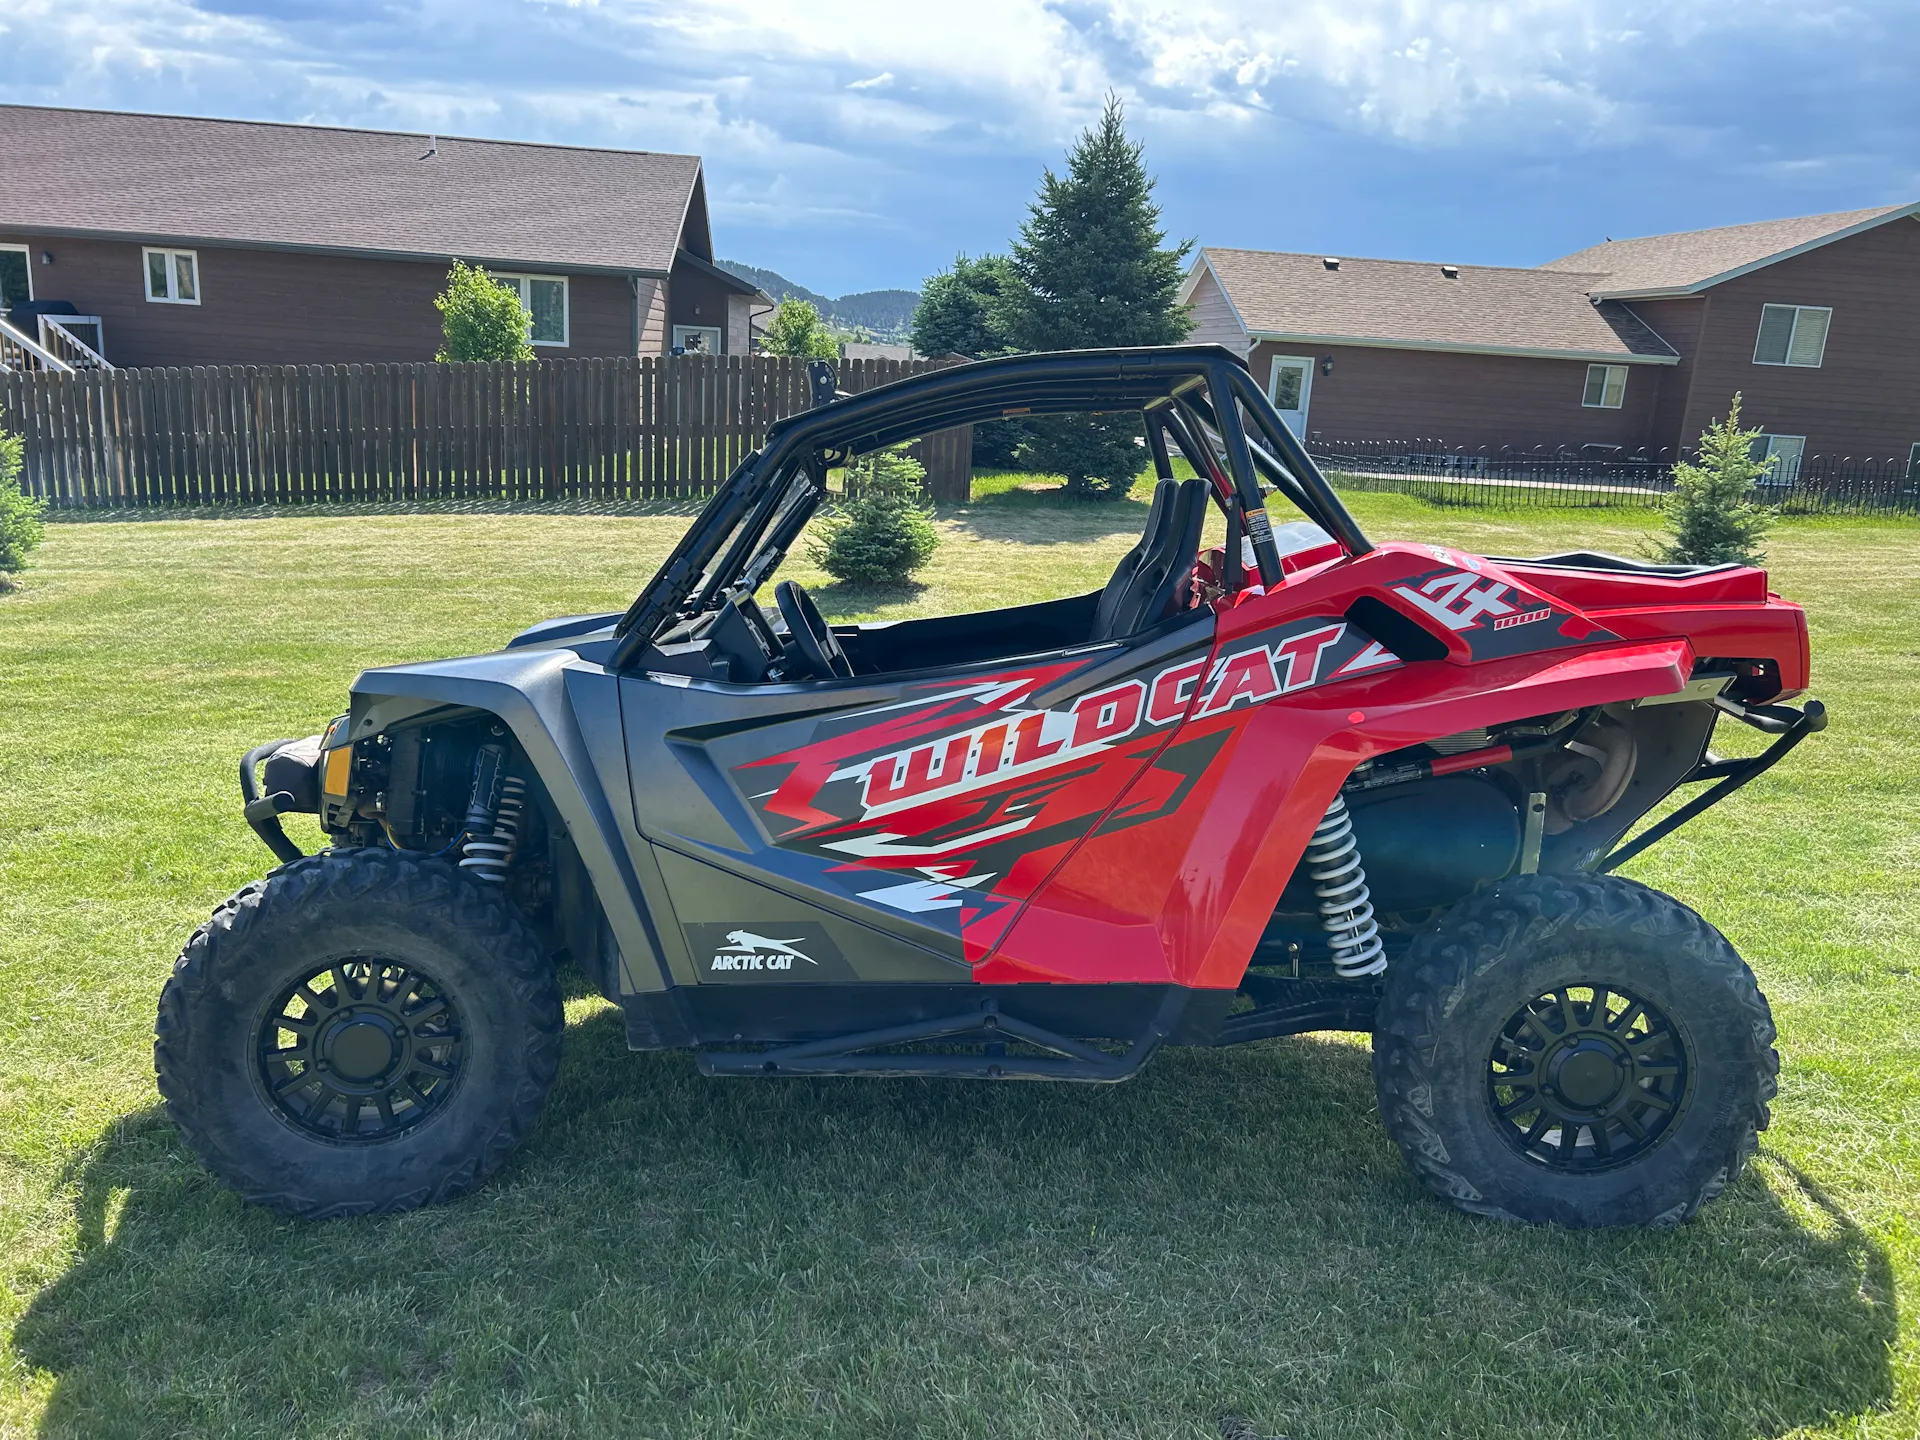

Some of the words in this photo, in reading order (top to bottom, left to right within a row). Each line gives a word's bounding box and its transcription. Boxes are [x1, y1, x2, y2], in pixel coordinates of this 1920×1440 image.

[1493, 607, 1552, 632] 1000
[858, 621, 1348, 814] WILDCAT
[710, 954, 765, 971] ARCTIC
[766, 954, 796, 970] CAT
